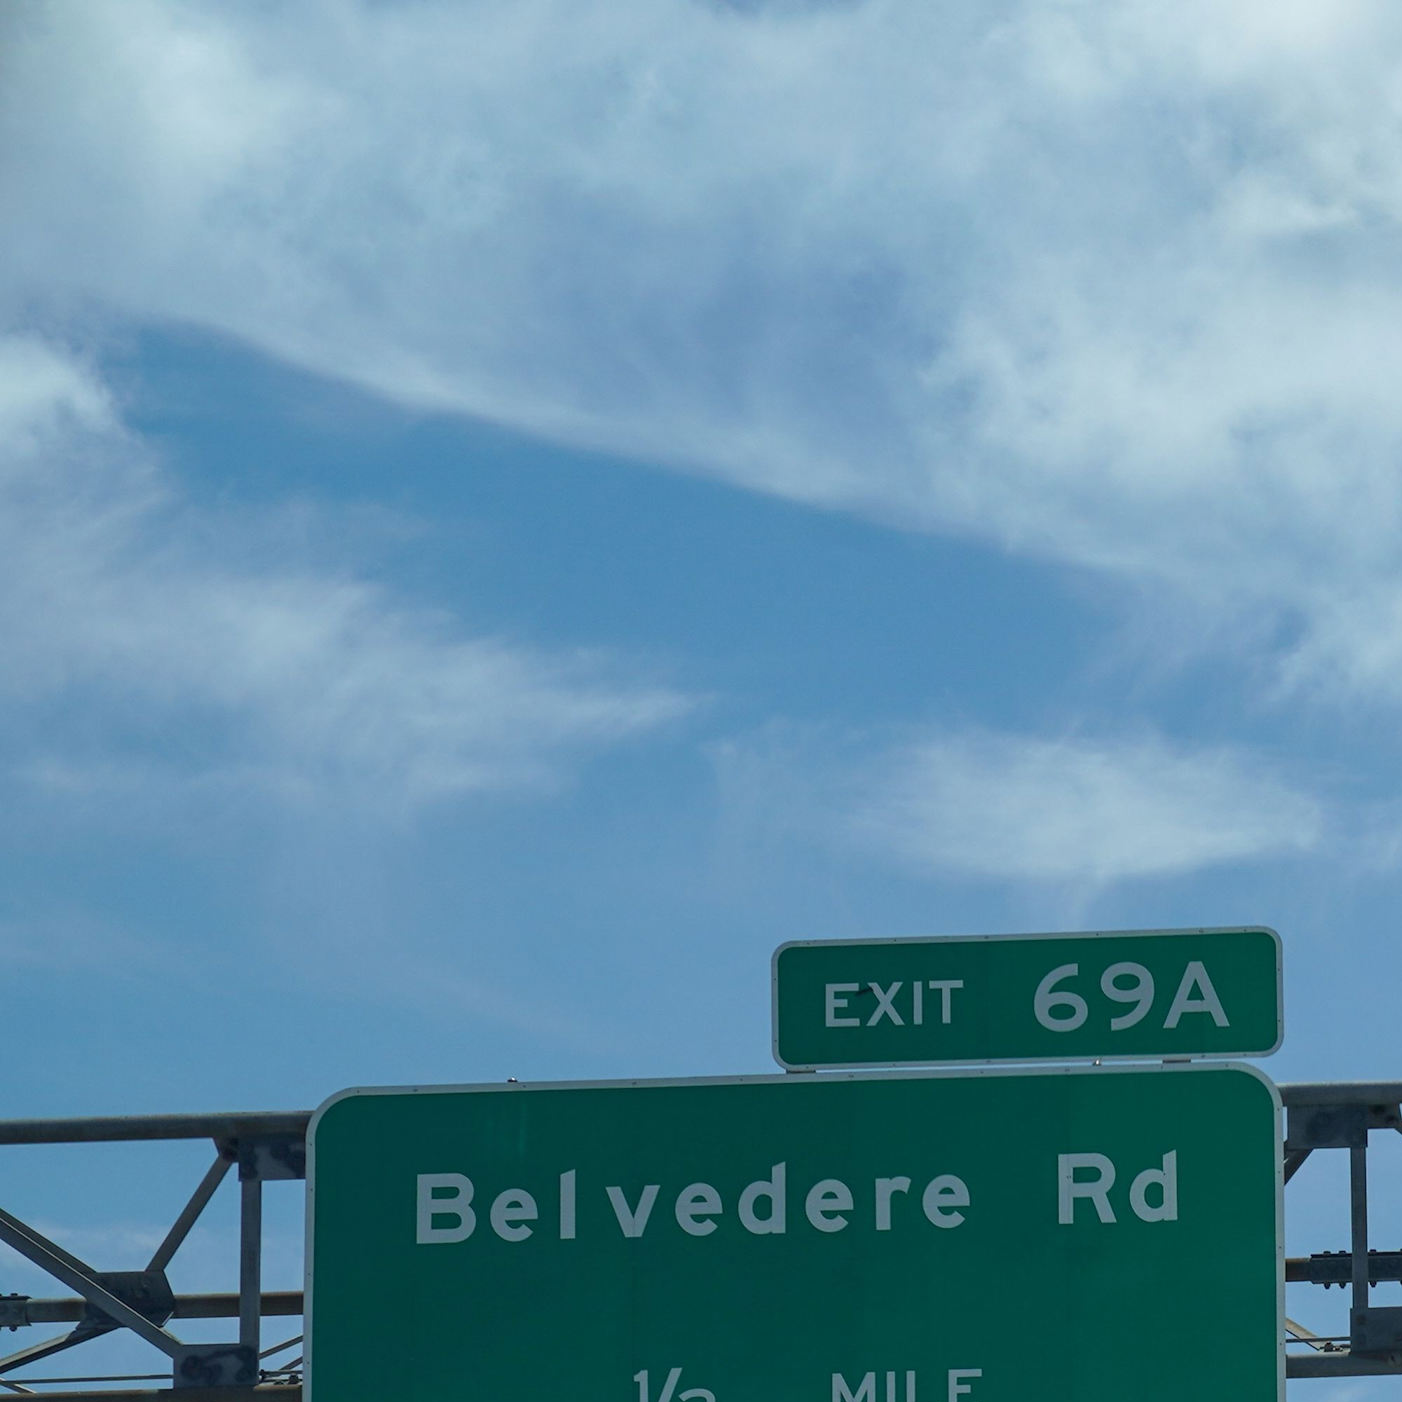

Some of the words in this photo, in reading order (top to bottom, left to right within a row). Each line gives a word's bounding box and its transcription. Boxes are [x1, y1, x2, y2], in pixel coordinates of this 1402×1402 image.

[826, 980, 963, 1027] EXIT
[1034, 961, 1230, 1032] 69A
[417, 1162, 970, 1244] Belvedere
[1058, 1150, 1177, 1224] Rd
